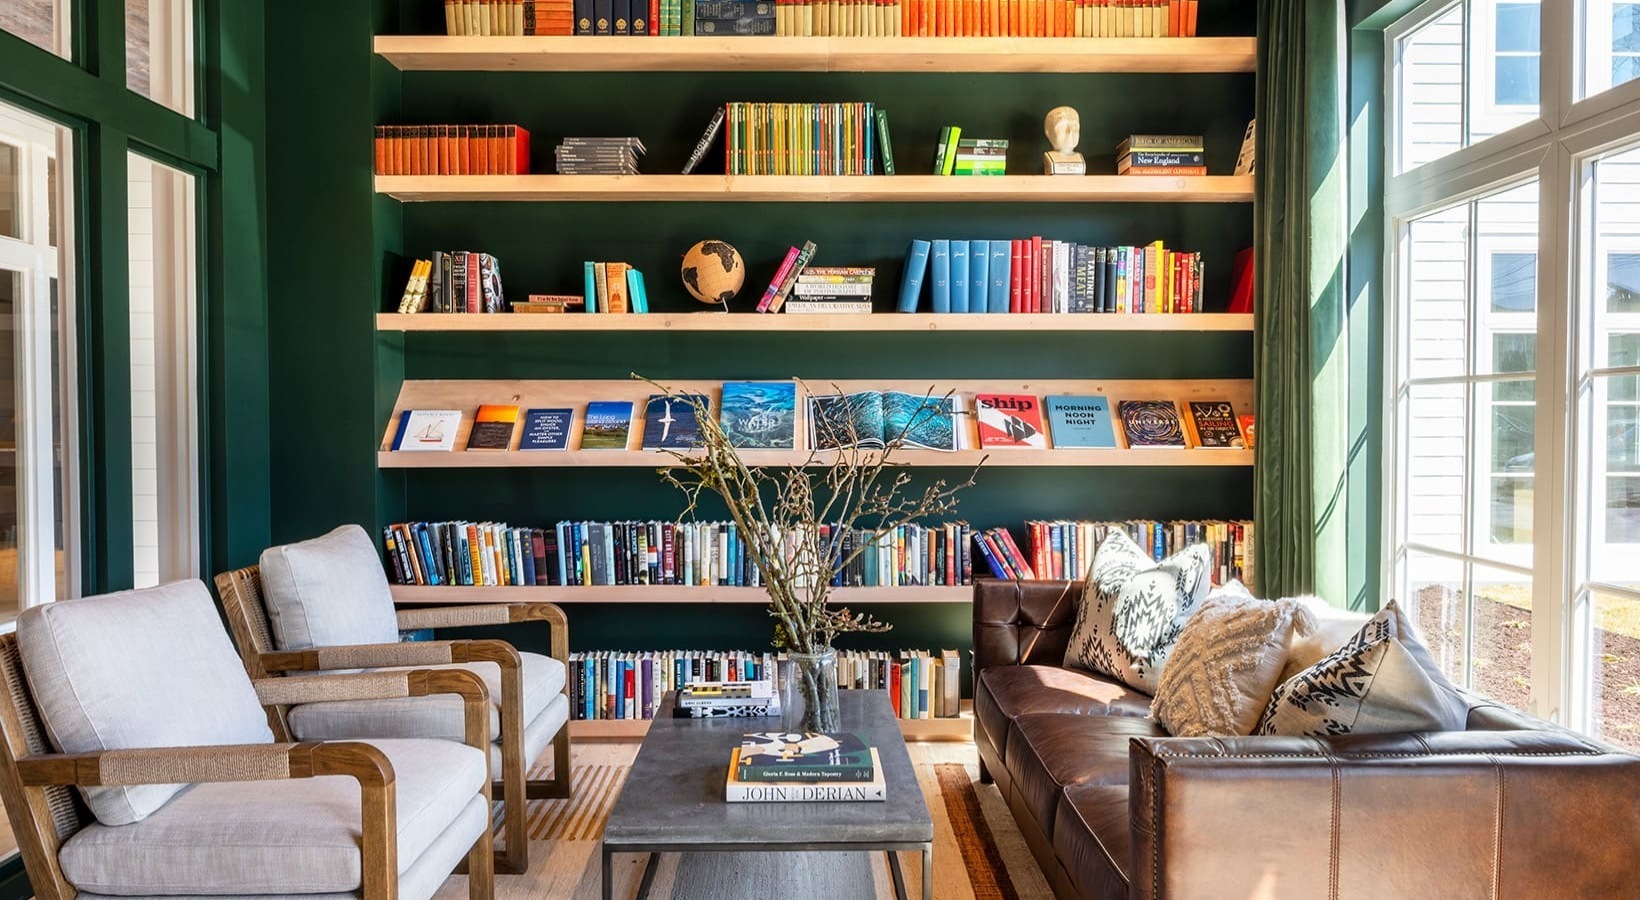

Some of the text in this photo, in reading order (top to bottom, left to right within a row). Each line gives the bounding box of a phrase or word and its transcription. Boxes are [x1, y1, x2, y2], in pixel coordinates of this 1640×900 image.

[1154, 157, 1180, 166] England
[1077, 266, 1086, 296] MEAT
[1087, 260, 1095, 295] TARTINE
[981, 397, 1032, 412] ship
[738, 418, 776, 428] WATER
[742, 787, 787, 800] JOHN
[802, 787, 866, 800] DERIAN
